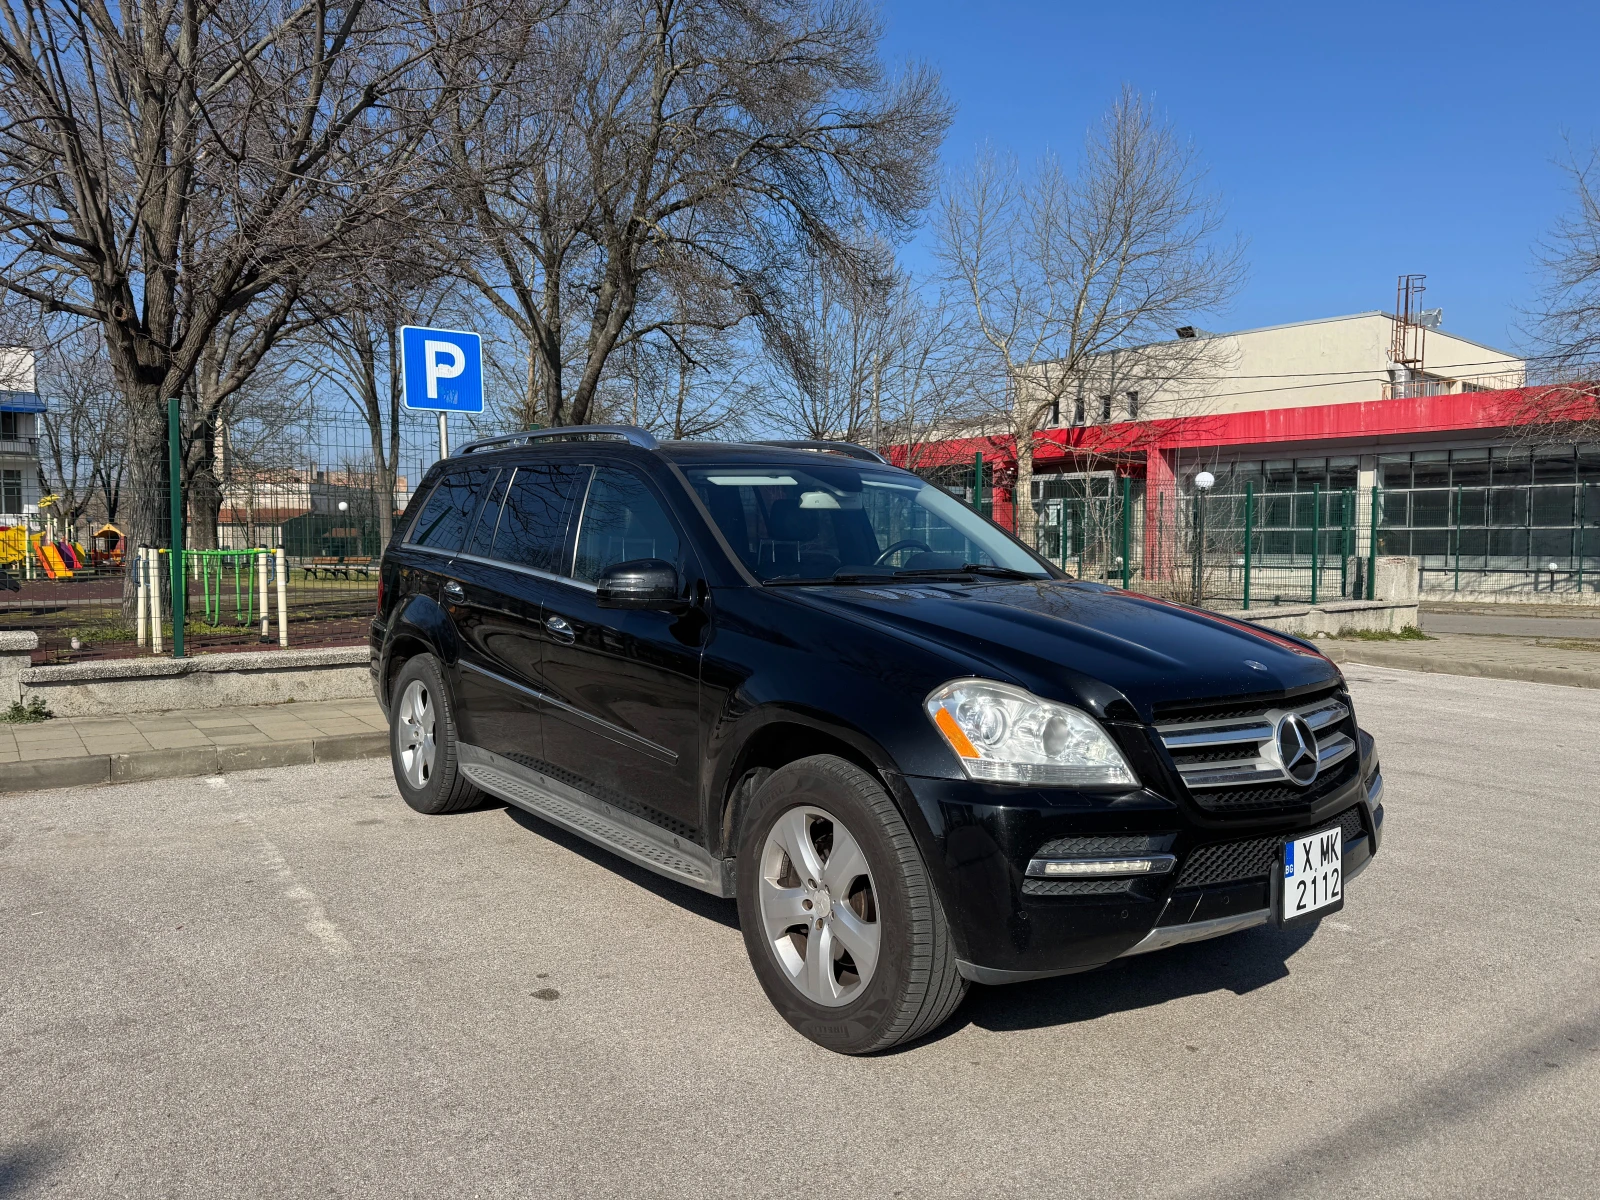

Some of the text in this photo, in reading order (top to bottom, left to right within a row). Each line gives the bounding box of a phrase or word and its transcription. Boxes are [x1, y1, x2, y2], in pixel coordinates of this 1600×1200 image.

[424, 339, 466, 399] P
[1285, 864, 1294, 875] BG
[1302, 831, 1340, 873] X MK
[1296, 867, 1340, 911] 2112
